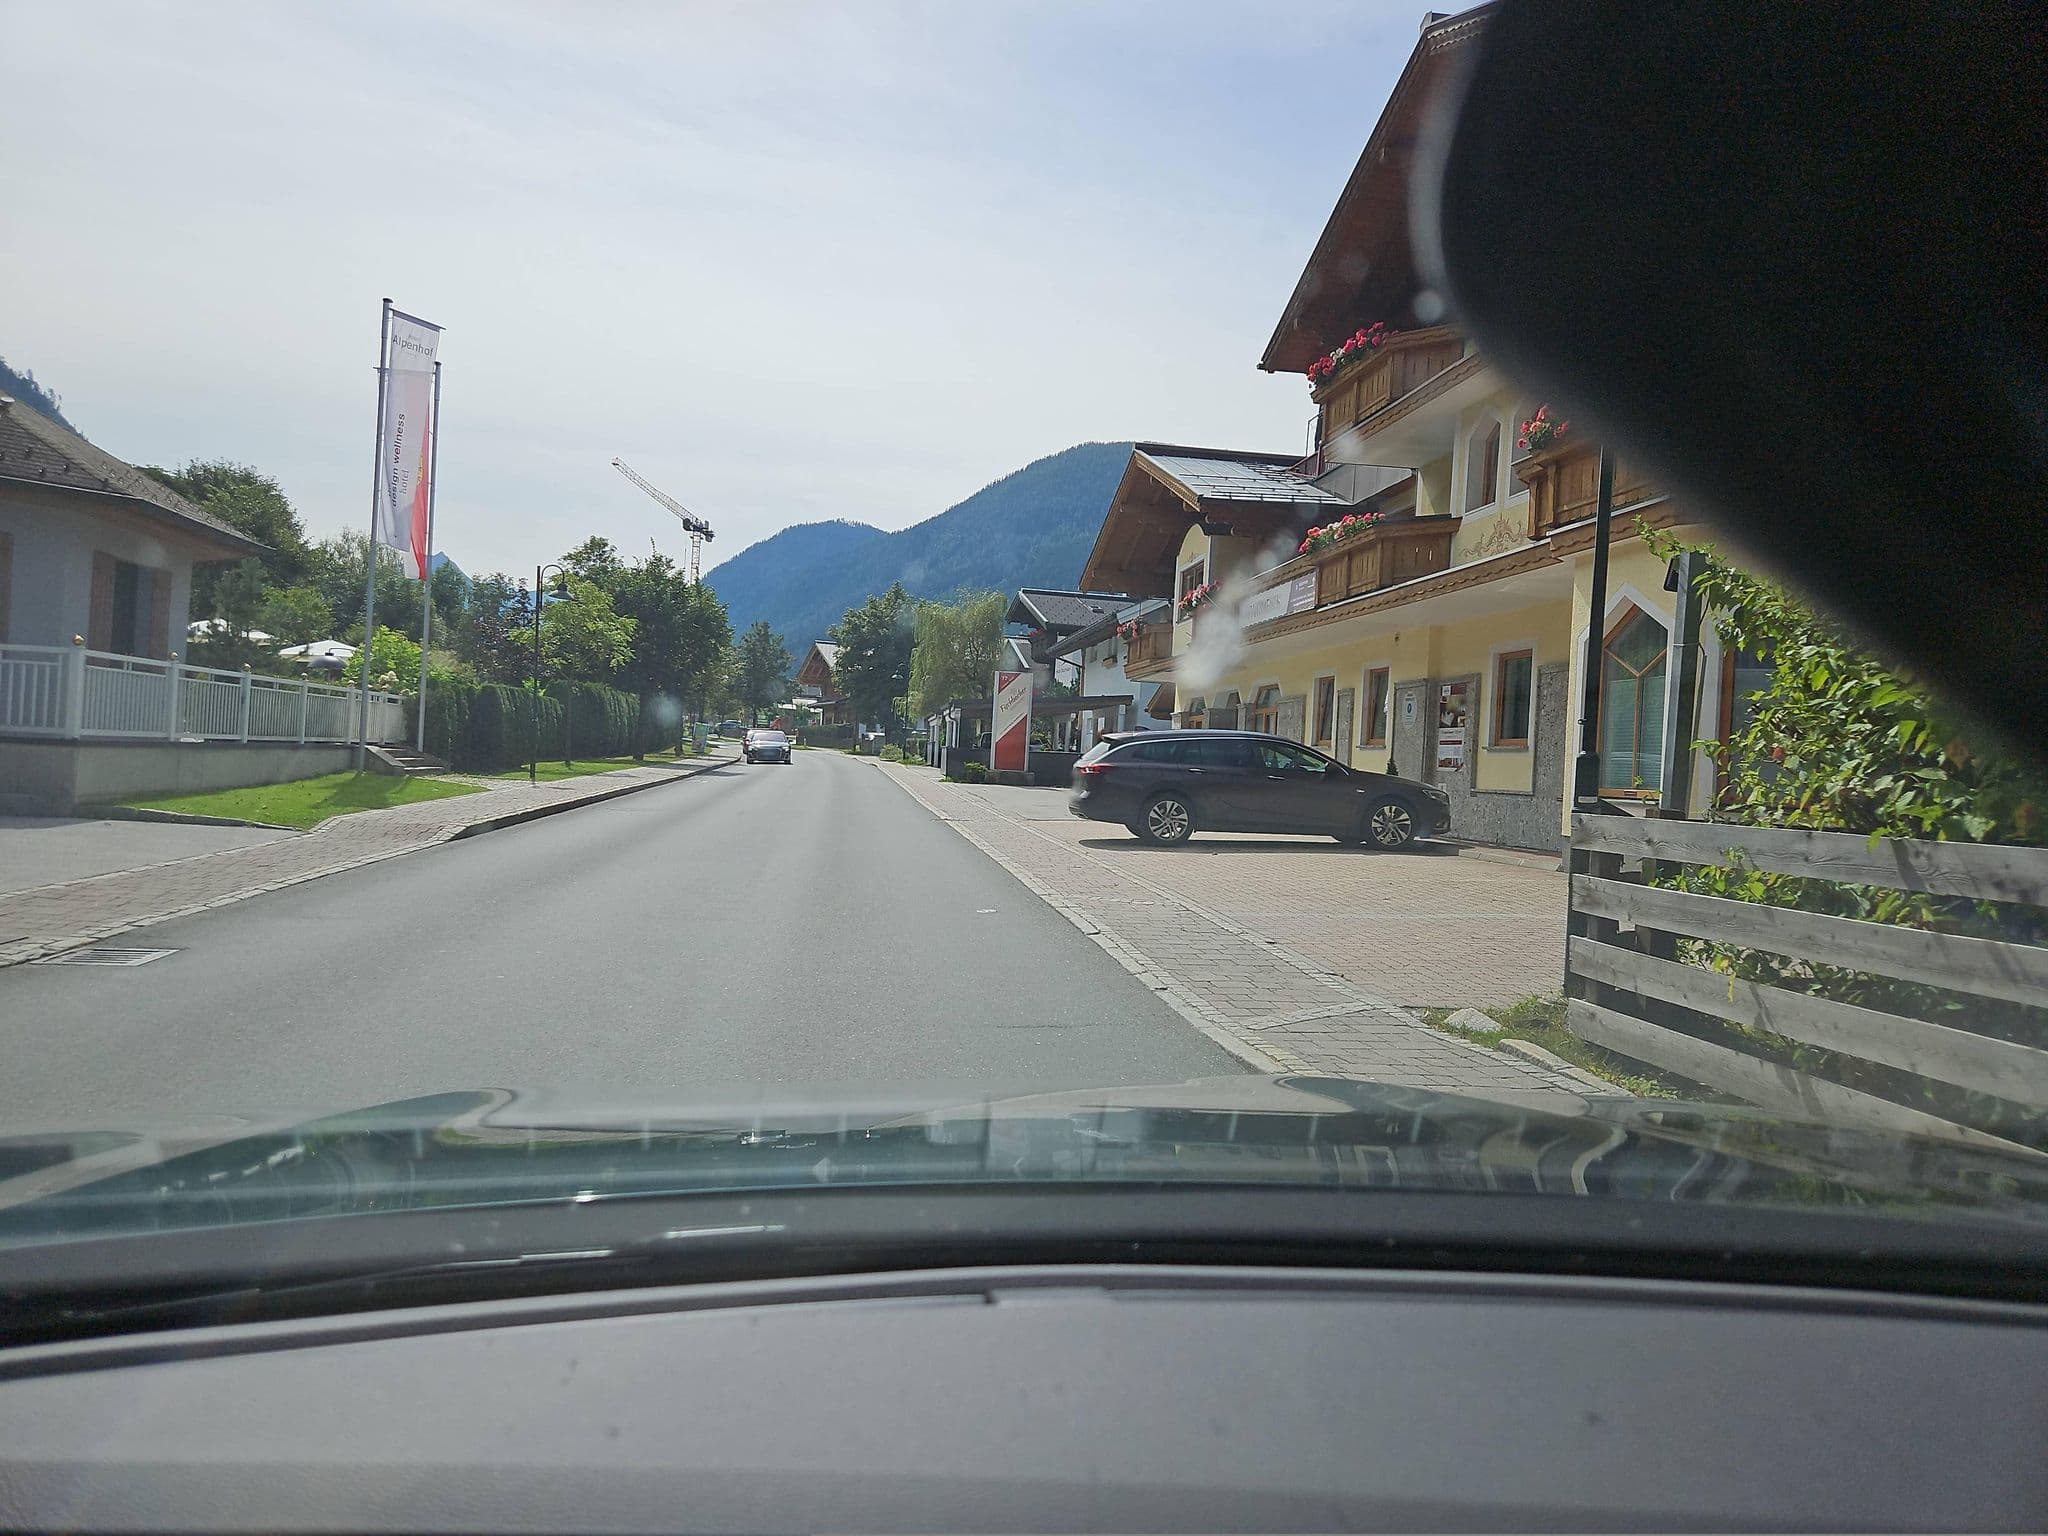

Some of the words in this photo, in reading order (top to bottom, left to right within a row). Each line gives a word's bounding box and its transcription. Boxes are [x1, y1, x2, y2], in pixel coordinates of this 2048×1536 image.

[393, 334, 434, 357] Alpenhof
[393, 413, 405, 464] wellness
[391, 468, 400, 507] design
[400, 469, 410, 495] hotel
